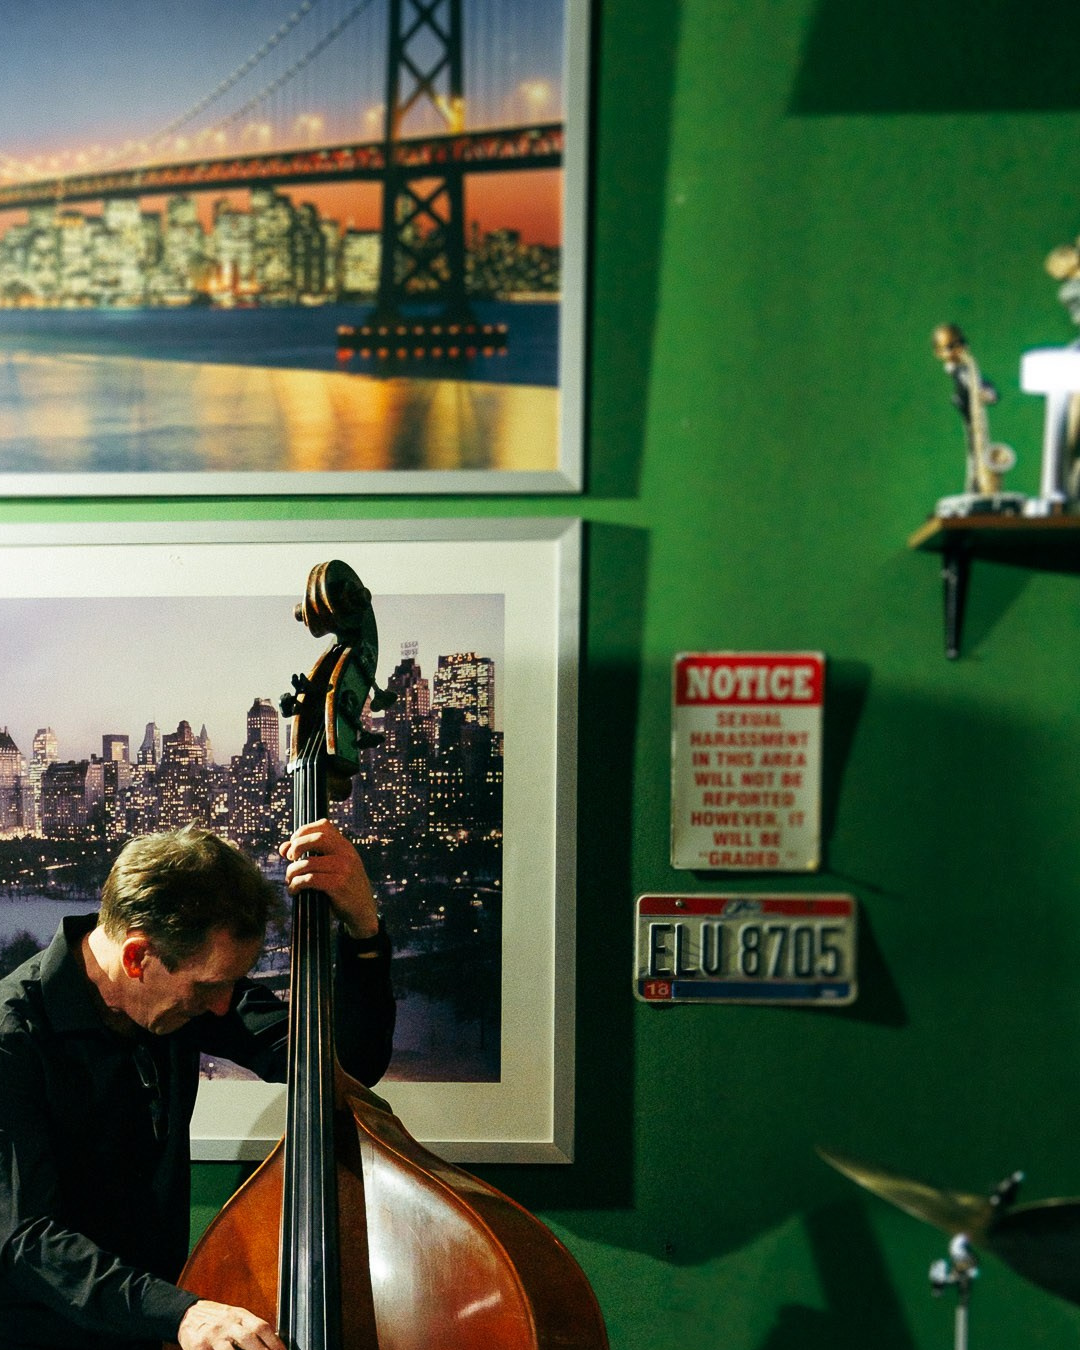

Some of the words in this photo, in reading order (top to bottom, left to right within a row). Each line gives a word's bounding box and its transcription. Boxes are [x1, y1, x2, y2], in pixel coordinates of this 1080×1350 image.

[686, 667, 813, 699] NOTICE
[690, 732, 808, 746] HARASSMENT
[692, 753, 709, 766] IN
[717, 752, 754, 766] THIS
[760, 752, 806, 766] AREA
[694, 772, 733, 787] WILL
[740, 772, 773, 787] NOT
[781, 772, 802, 787] BE
[702, 792, 795, 807] REPORTED
[788, 812, 804, 827] IT
[713, 832, 752, 847] WILL
[760, 832, 780, 846] BE
[649, 922, 722, 976] ELU
[738, 923, 845, 977] 8705
